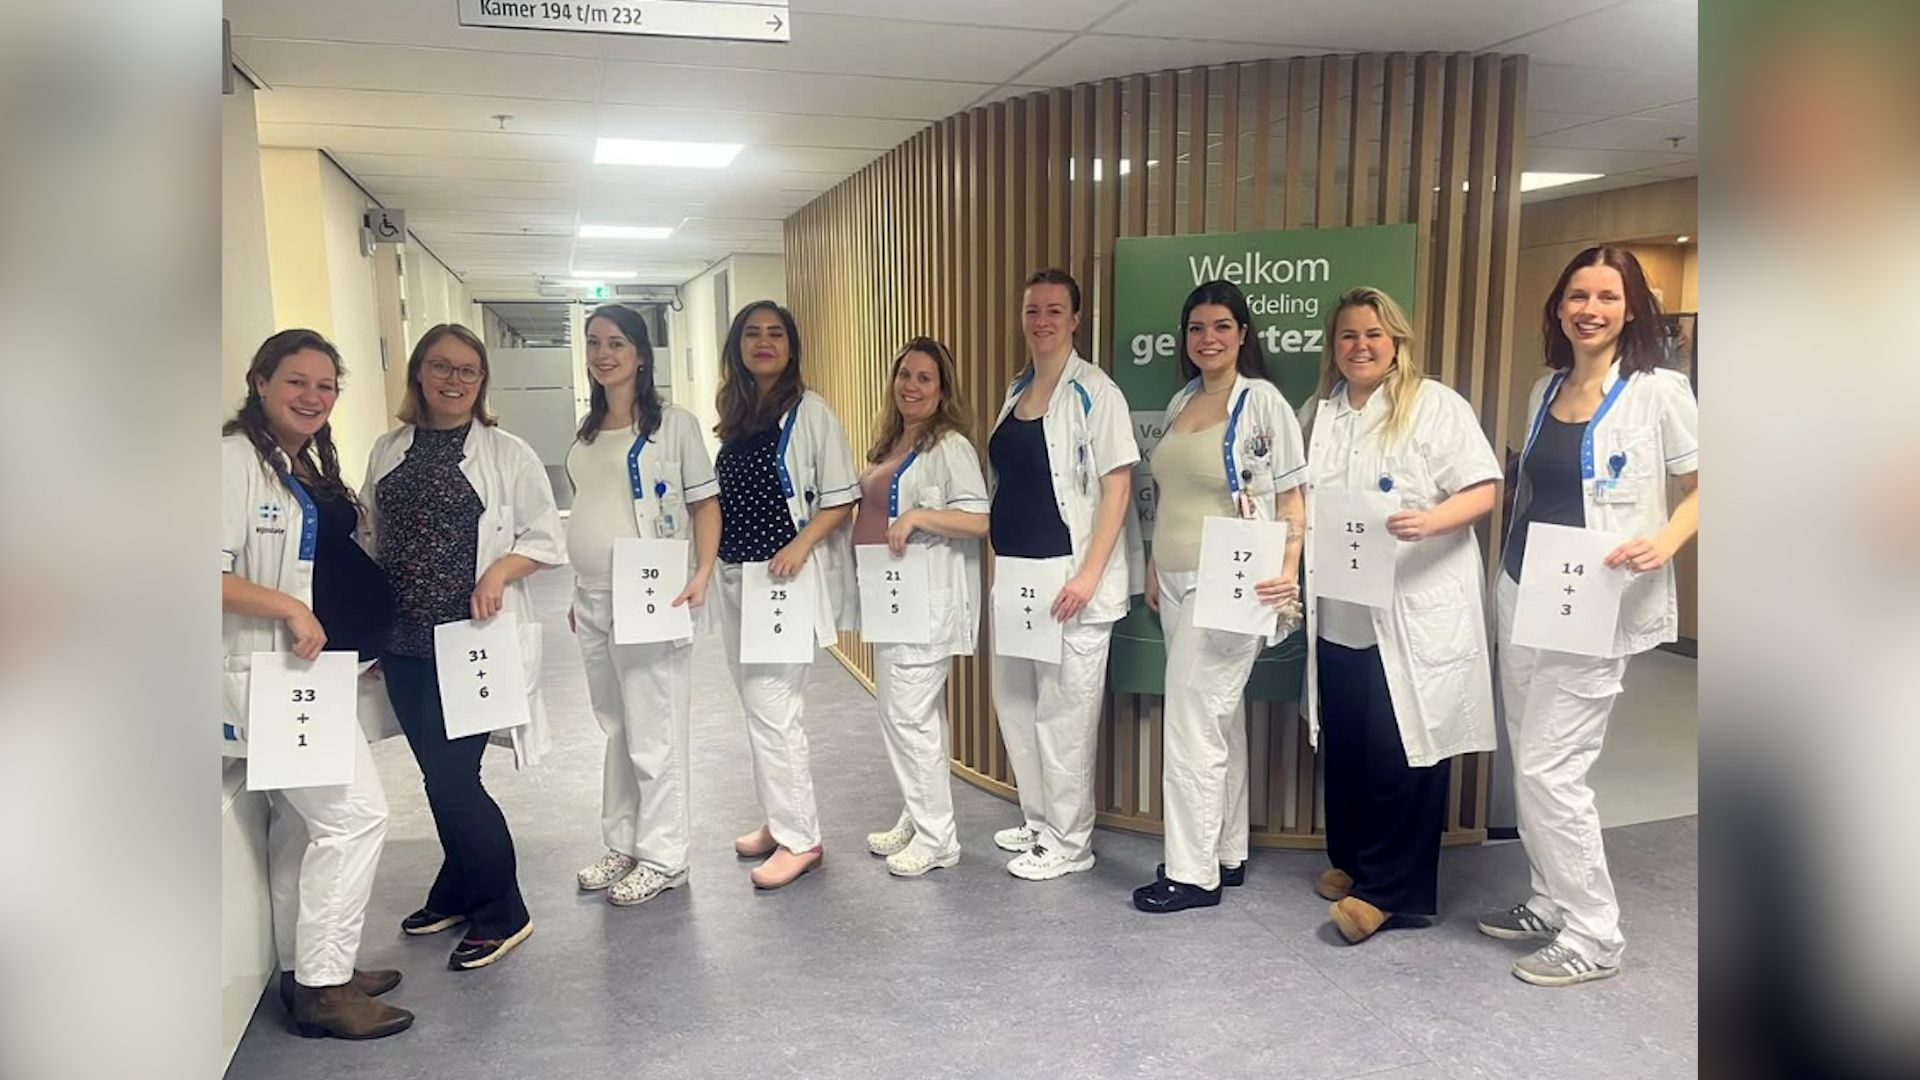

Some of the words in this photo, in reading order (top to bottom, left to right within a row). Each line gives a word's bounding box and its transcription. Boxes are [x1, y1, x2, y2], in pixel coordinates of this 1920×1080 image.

[480, 0, 536, 17] Kamer
[541, 2, 572, 20] 194
[576, 4, 607, 24] t/m
[612, 7, 642, 25] 232
[1189, 252, 1330, 286] Welkom
[1245, 294, 1319, 318] fdeling
[1346, 522, 1365, 533] 15
[1350, 541, 1360, 550] +
[1233, 551, 1252, 562] 17
[1351, 558, 1358, 569] 1
[642, 569, 659, 579] 30
[1562, 563, 1584, 576] 14
[886, 571, 901, 581] 21
[1235, 571, 1245, 580] +
[646, 587, 654, 596] +
[771, 591, 787, 600] 25
[890, 588, 898, 597] +
[1021, 587, 1035, 598] 21
[1233, 588, 1242, 599] 5
[1564, 585, 1575, 595] +
[647, 603, 655, 614] 0
[774, 608, 782, 616] +
[892, 604, 899, 613] 5
[1024, 606, 1032, 614] +
[1561, 604, 1571, 615] 3
[774, 623, 782, 634] 6
[1026, 621, 1032, 630] 1
[469, 649, 487, 662] 31
[476, 670, 486, 679] +
[292, 689, 316, 702] 33
[479, 686, 489, 698] 6
[297, 713, 309, 724] +
[298, 734, 307, 747] 1
